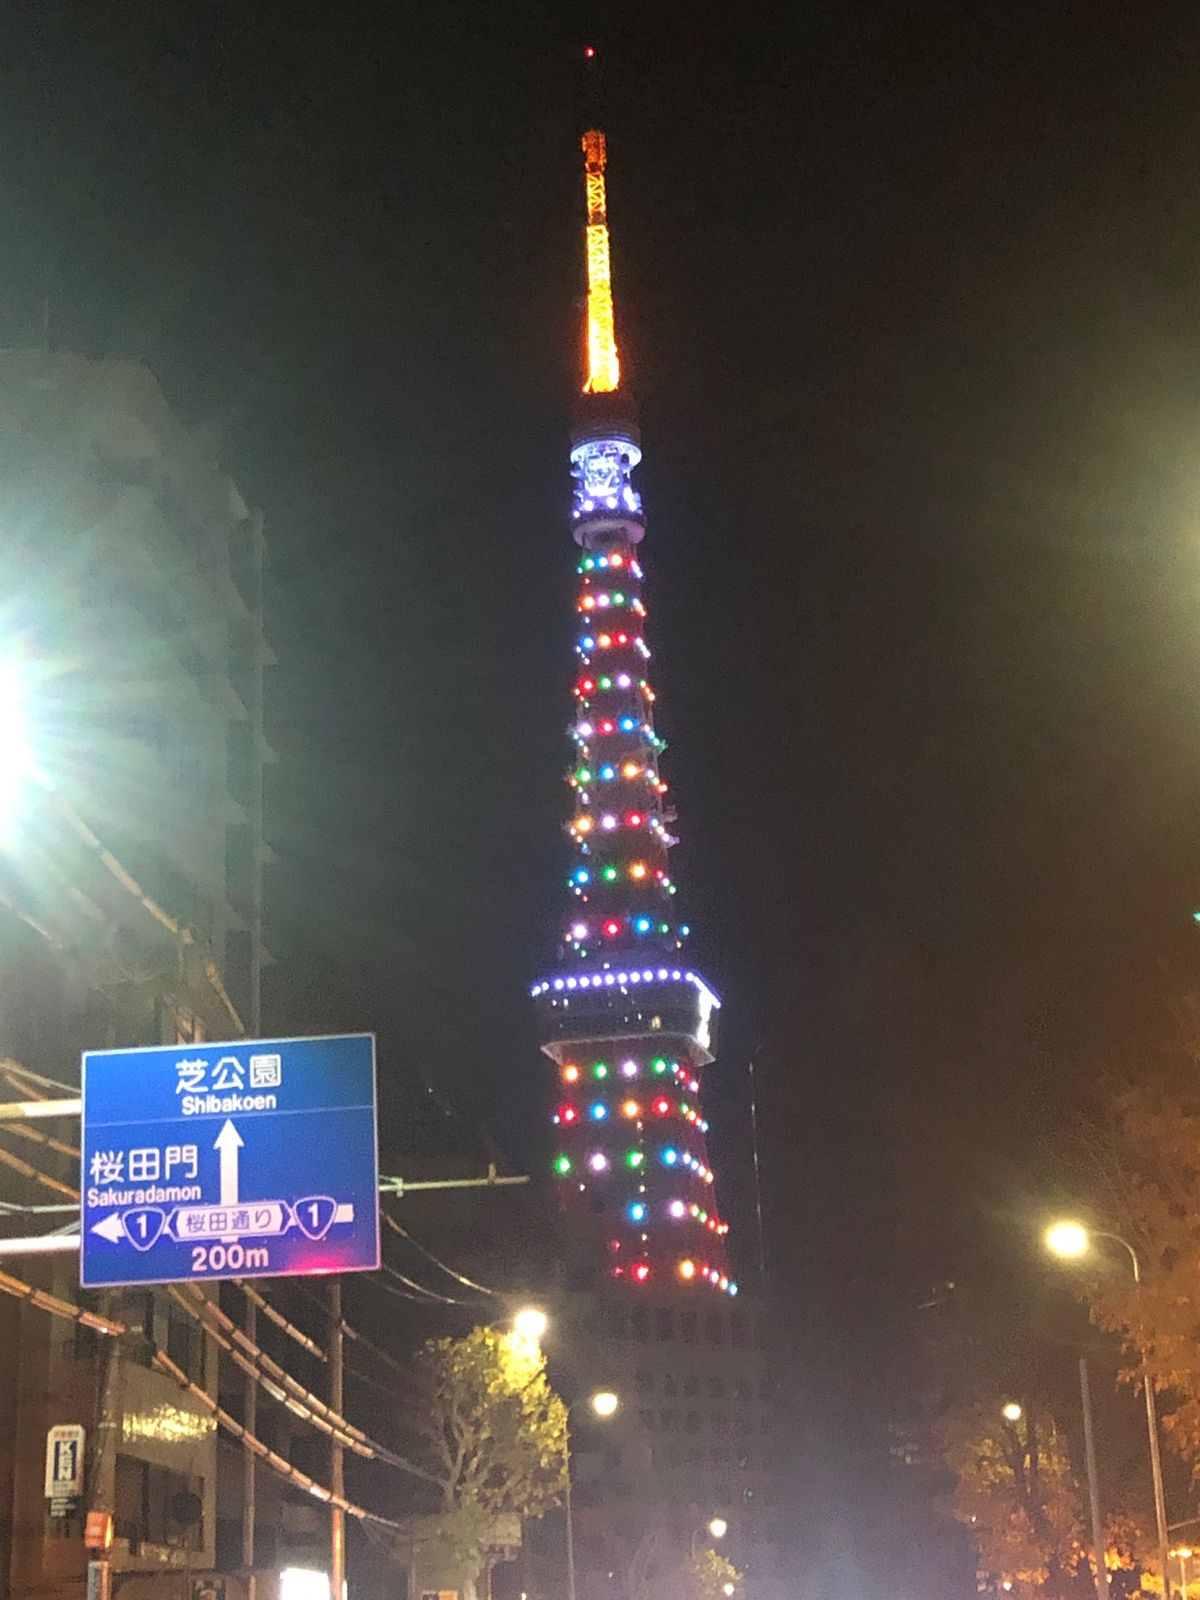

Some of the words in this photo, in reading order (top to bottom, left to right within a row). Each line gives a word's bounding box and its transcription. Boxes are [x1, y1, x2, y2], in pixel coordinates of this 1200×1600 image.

[175, 1054, 281, 1094] 芝公園
[181, 1094, 277, 1115] Shibakoen
[89, 1144, 199, 1185] 桜田門
[87, 1185, 202, 1208] Sakuradamon
[135, 1214, 149, 1239] 1
[185, 1208, 272, 1234] 桜田通り
[307, 1203, 321, 1227] 1
[191, 1246, 269, 1272] 200m
